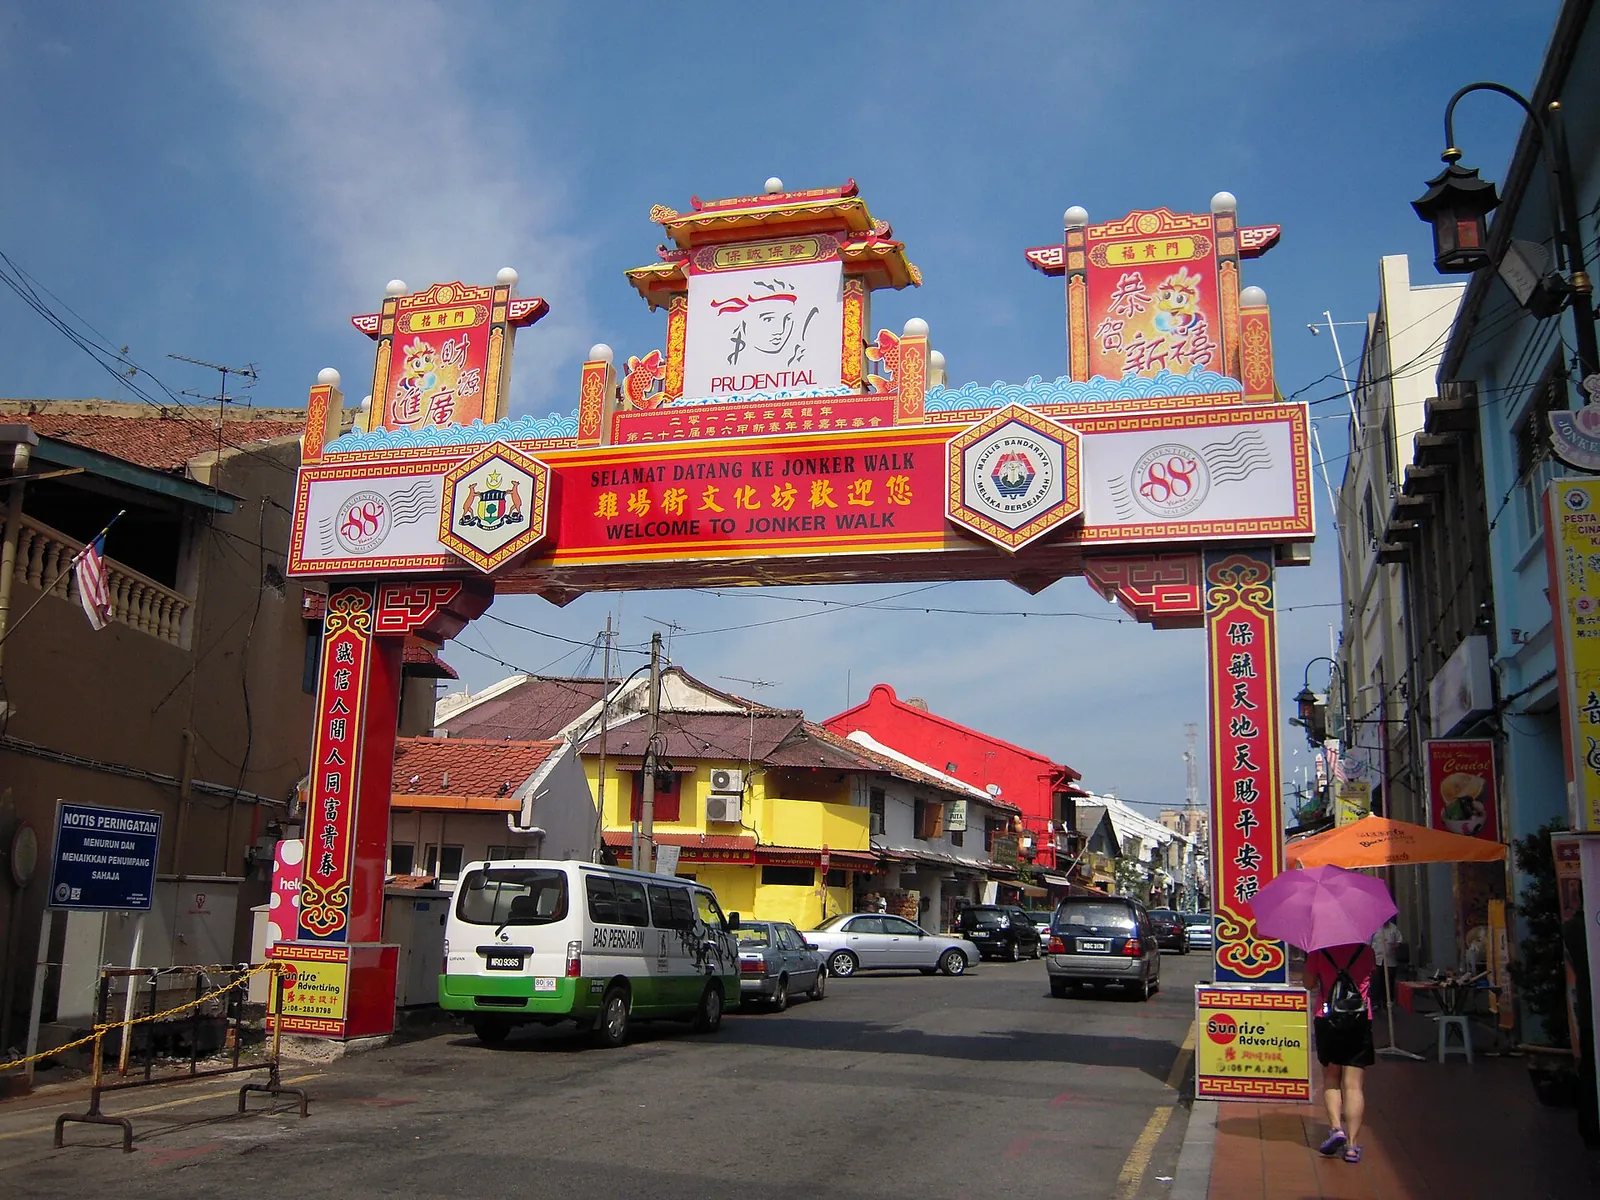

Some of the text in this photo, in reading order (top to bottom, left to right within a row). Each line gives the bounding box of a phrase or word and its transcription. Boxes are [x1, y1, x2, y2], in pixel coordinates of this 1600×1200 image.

[725, 243, 806, 263] 保誠保險
[710, 369, 818, 393] PRUDENTIAL
[1557, 419, 1600, 453] JONKE
[977, 439, 1049, 471] MAJLIS BANDARAYA
[1139, 448, 1192, 471] PRUDENTIAL
[590, 452, 915, 488] SELAMAT DATANG KE JONKER WALK
[1139, 456, 1197, 503] 88
[593, 474, 914, 521] 雞場街文化坊歡迎您
[977, 478, 1051, 511] MELAKA BERSEJARAH
[340, 501, 385, 541] 88
[606, 511, 896, 541] WELCOME TO JONKER WALK
[1563, 513, 1597, 523] PESTA
[318, 641, 355, 877] 誠信人間人同富貴春
[63, 812, 157, 833] NOTIS PERINGATAN
[83, 837, 136, 851] MENURUN DAN
[61, 852, 151, 867] MENAIKKAN PENUMPANG
[91, 870, 120, 881] SAHAJA
[592, 927, 645, 950] BAS PERSIARAN
[281, 970, 318, 982] unrise
[297, 982, 341, 995] Advertising
[1208, 1020, 1266, 1035] Sunrise
